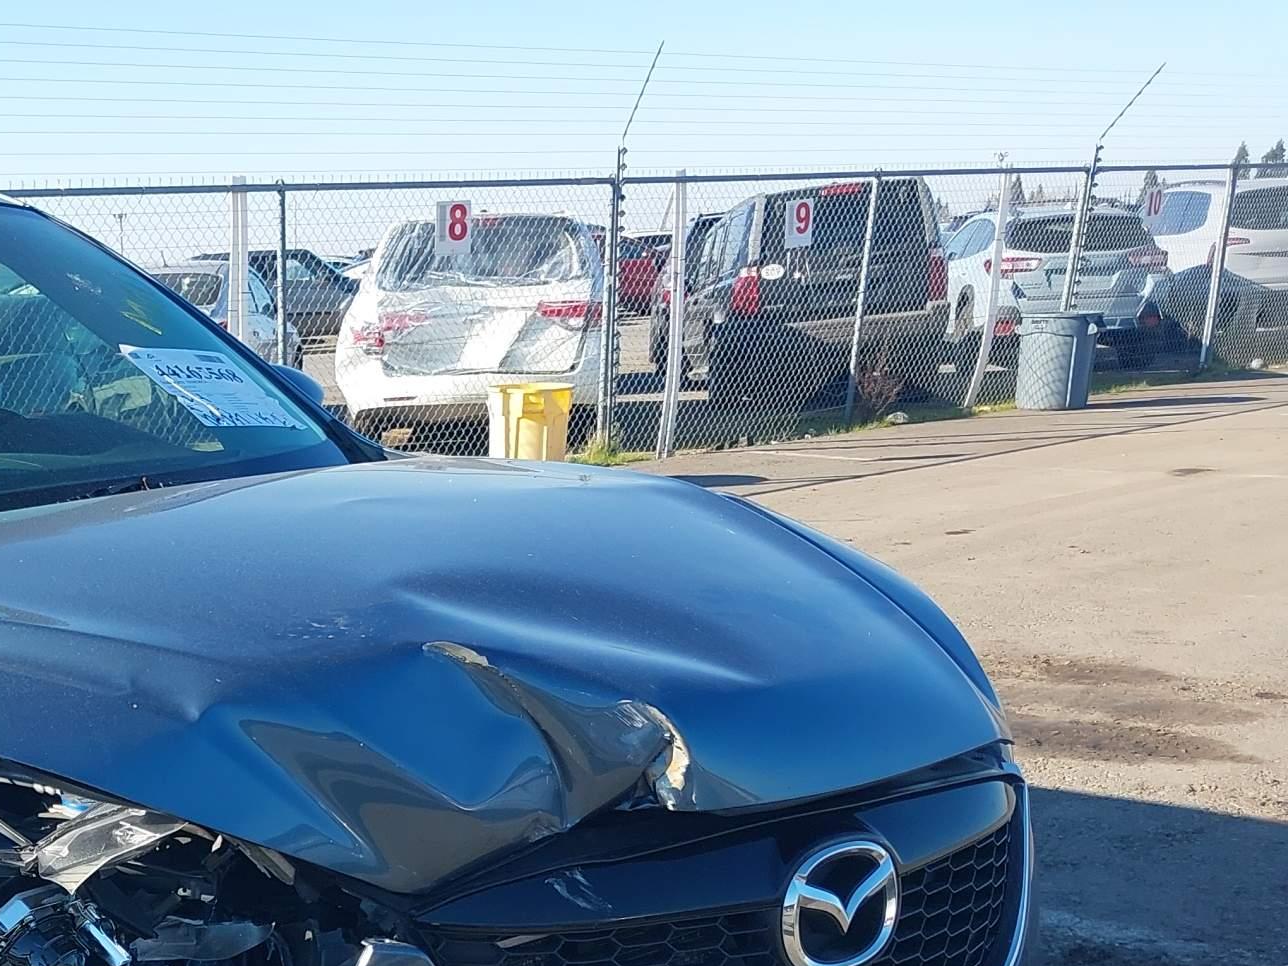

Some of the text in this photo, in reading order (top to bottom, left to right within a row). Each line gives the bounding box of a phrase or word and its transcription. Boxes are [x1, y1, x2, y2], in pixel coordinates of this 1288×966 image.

[795, 202, 811, 234] 9
[1147, 189, 1162, 216] 10
[448, 203, 467, 241] 8
